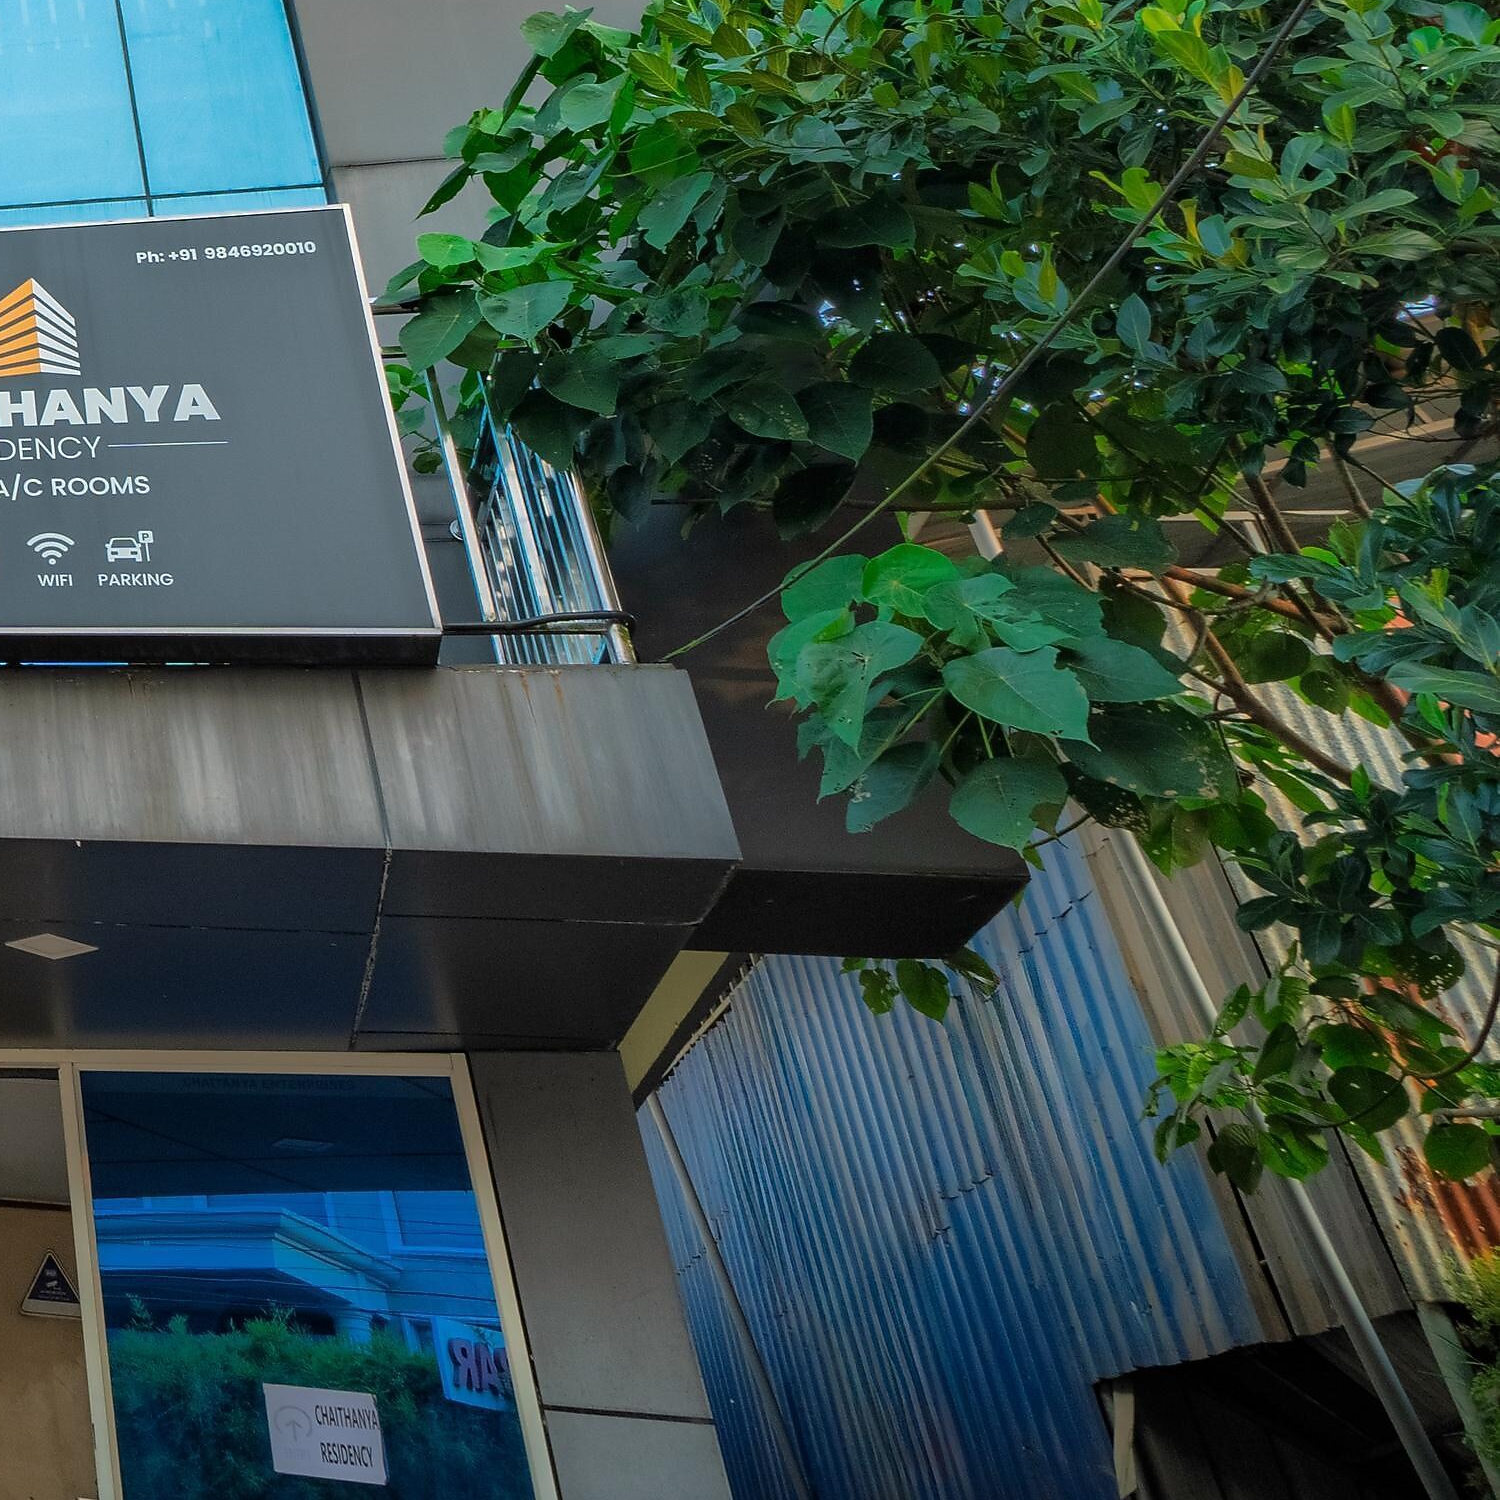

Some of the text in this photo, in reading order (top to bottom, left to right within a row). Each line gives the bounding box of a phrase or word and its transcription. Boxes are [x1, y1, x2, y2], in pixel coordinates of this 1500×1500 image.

[136, 241, 316, 264] Ph: +91 9846920010
[51, 475, 151, 496] ROOMS
[37, 574, 73, 587] WIFI
[98, 573, 174, 587] PARKING
[315, 1405, 380, 1430] CHAITHANYA
[320, 1442, 373, 1467] RESIDENCY
